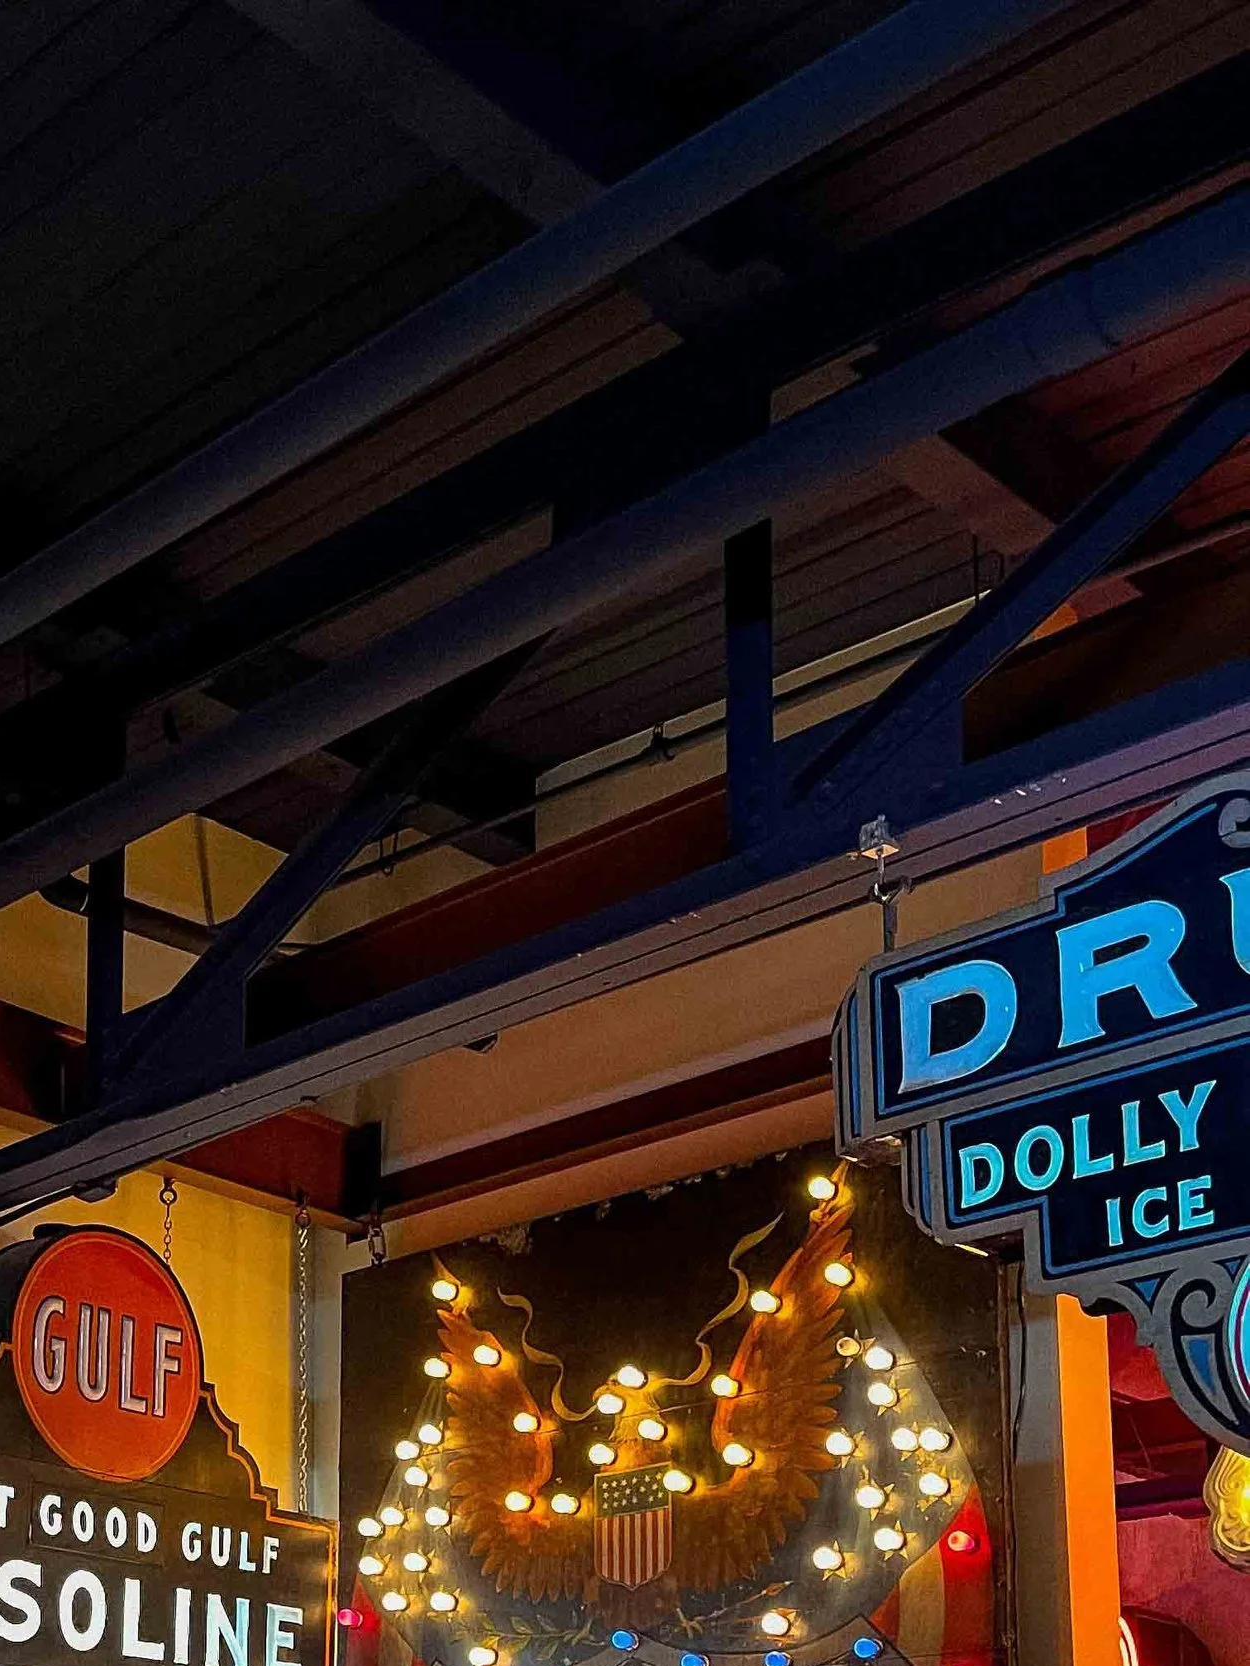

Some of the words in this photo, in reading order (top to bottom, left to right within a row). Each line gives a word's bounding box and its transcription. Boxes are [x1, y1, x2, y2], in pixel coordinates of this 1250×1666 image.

[897, 868, 1250, 1094] DR
[959, 1080, 1217, 1209] DOLLY
[1105, 1175, 1215, 1247] ICE
[32, 1295, 183, 1418] GULF
[39, 1494, 158, 1554] GOOD
[181, 1521, 280, 1575] GULF
